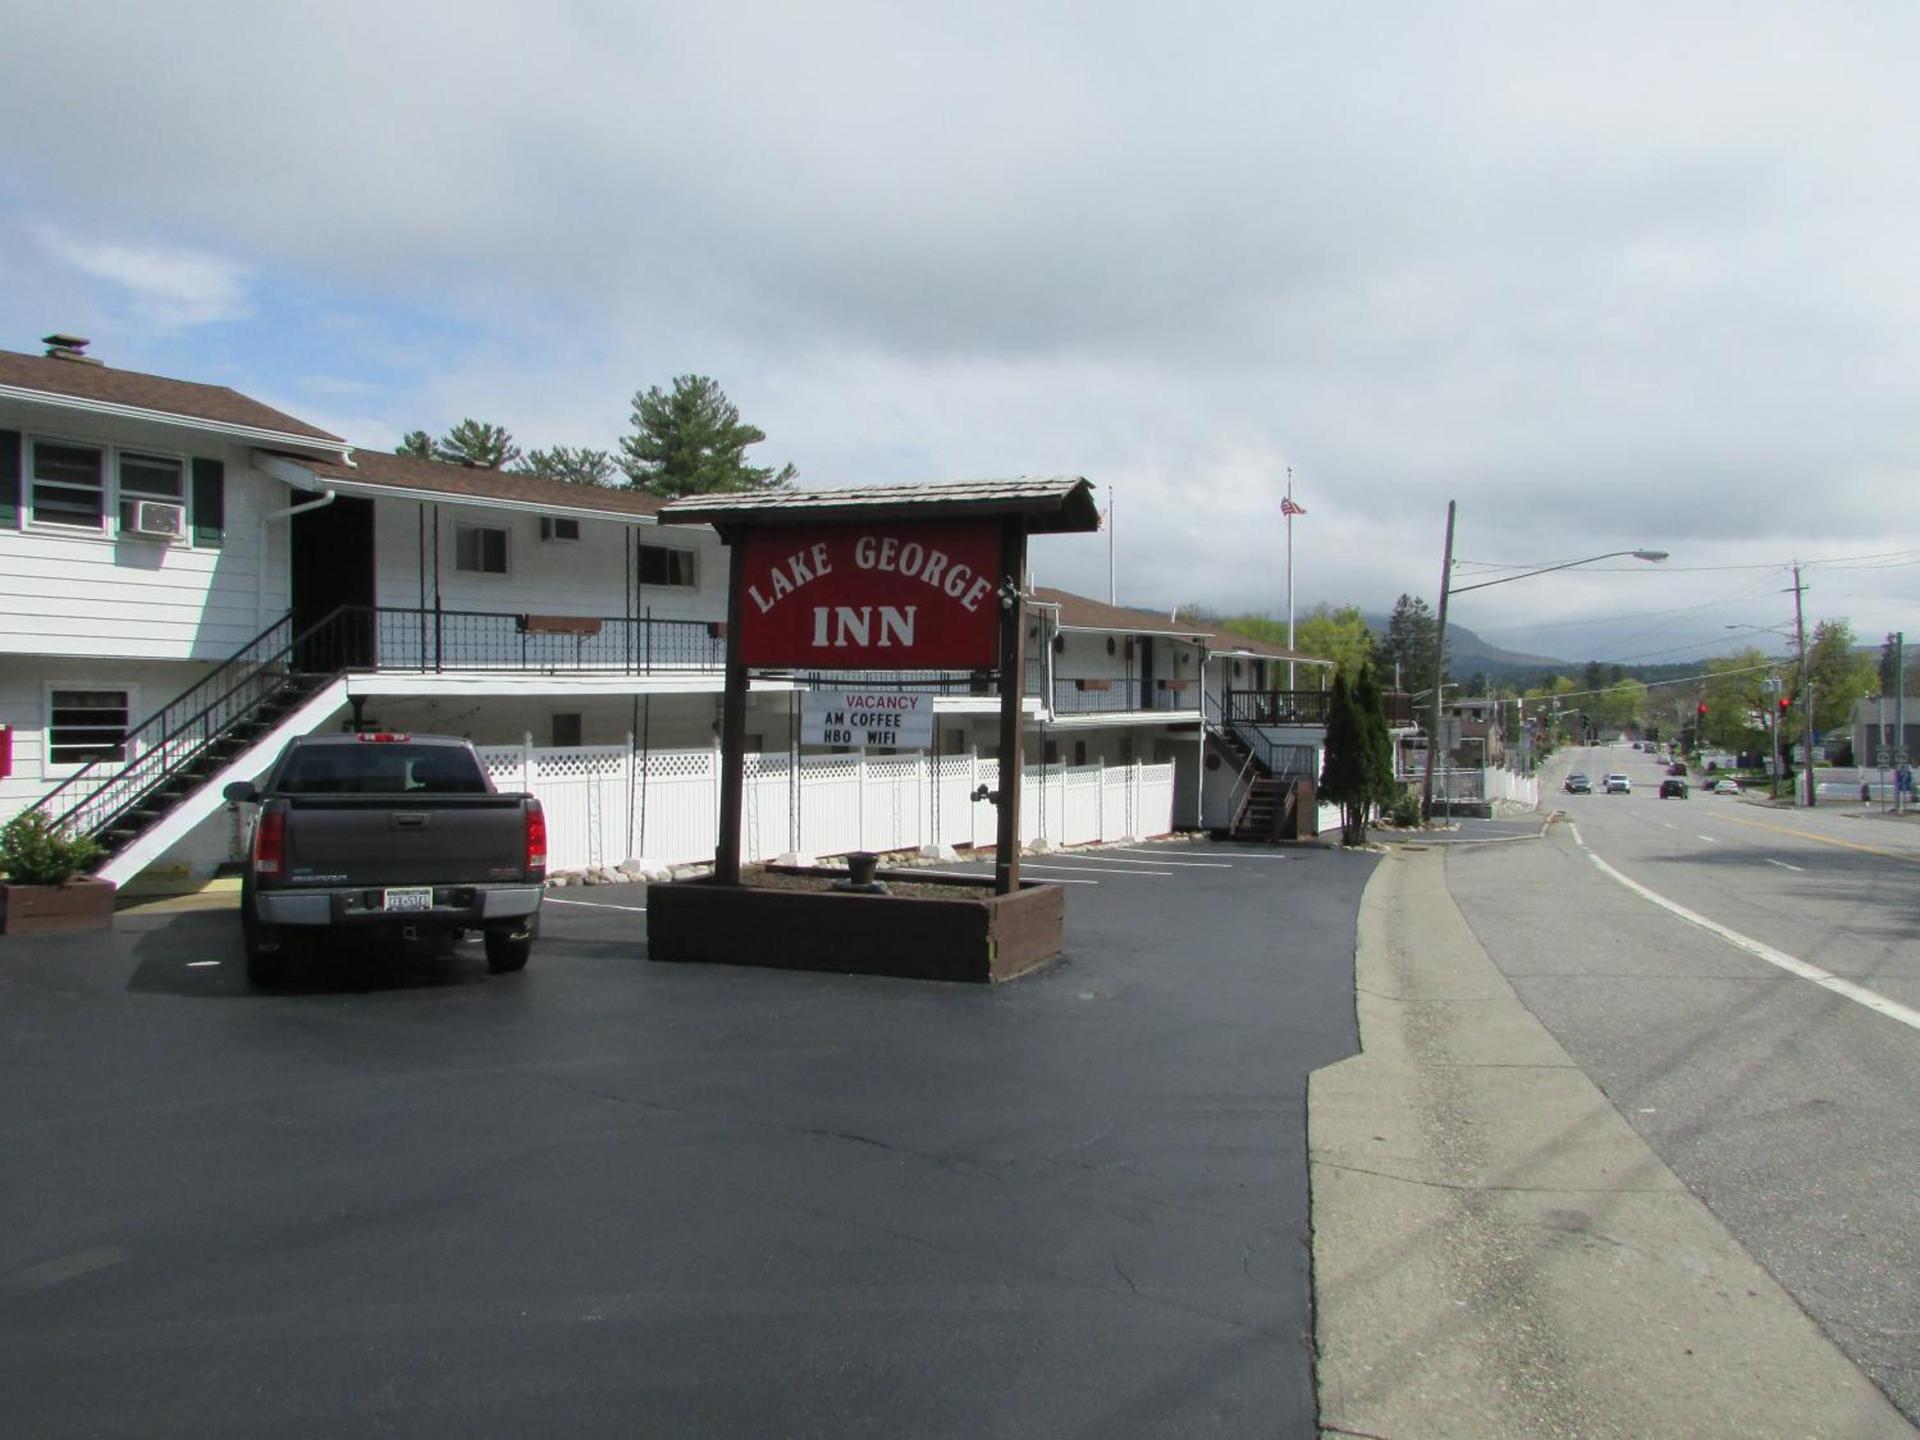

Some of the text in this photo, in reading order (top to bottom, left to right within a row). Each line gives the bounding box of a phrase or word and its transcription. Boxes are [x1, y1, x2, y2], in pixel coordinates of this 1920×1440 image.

[748, 536, 992, 613] LAKE GEORGE
[811, 605, 917, 647] INN
[846, 695, 918, 710] VACANCY
[825, 712, 902, 727] AM COFFEE
[824, 729, 896, 744] HBO WIFI
